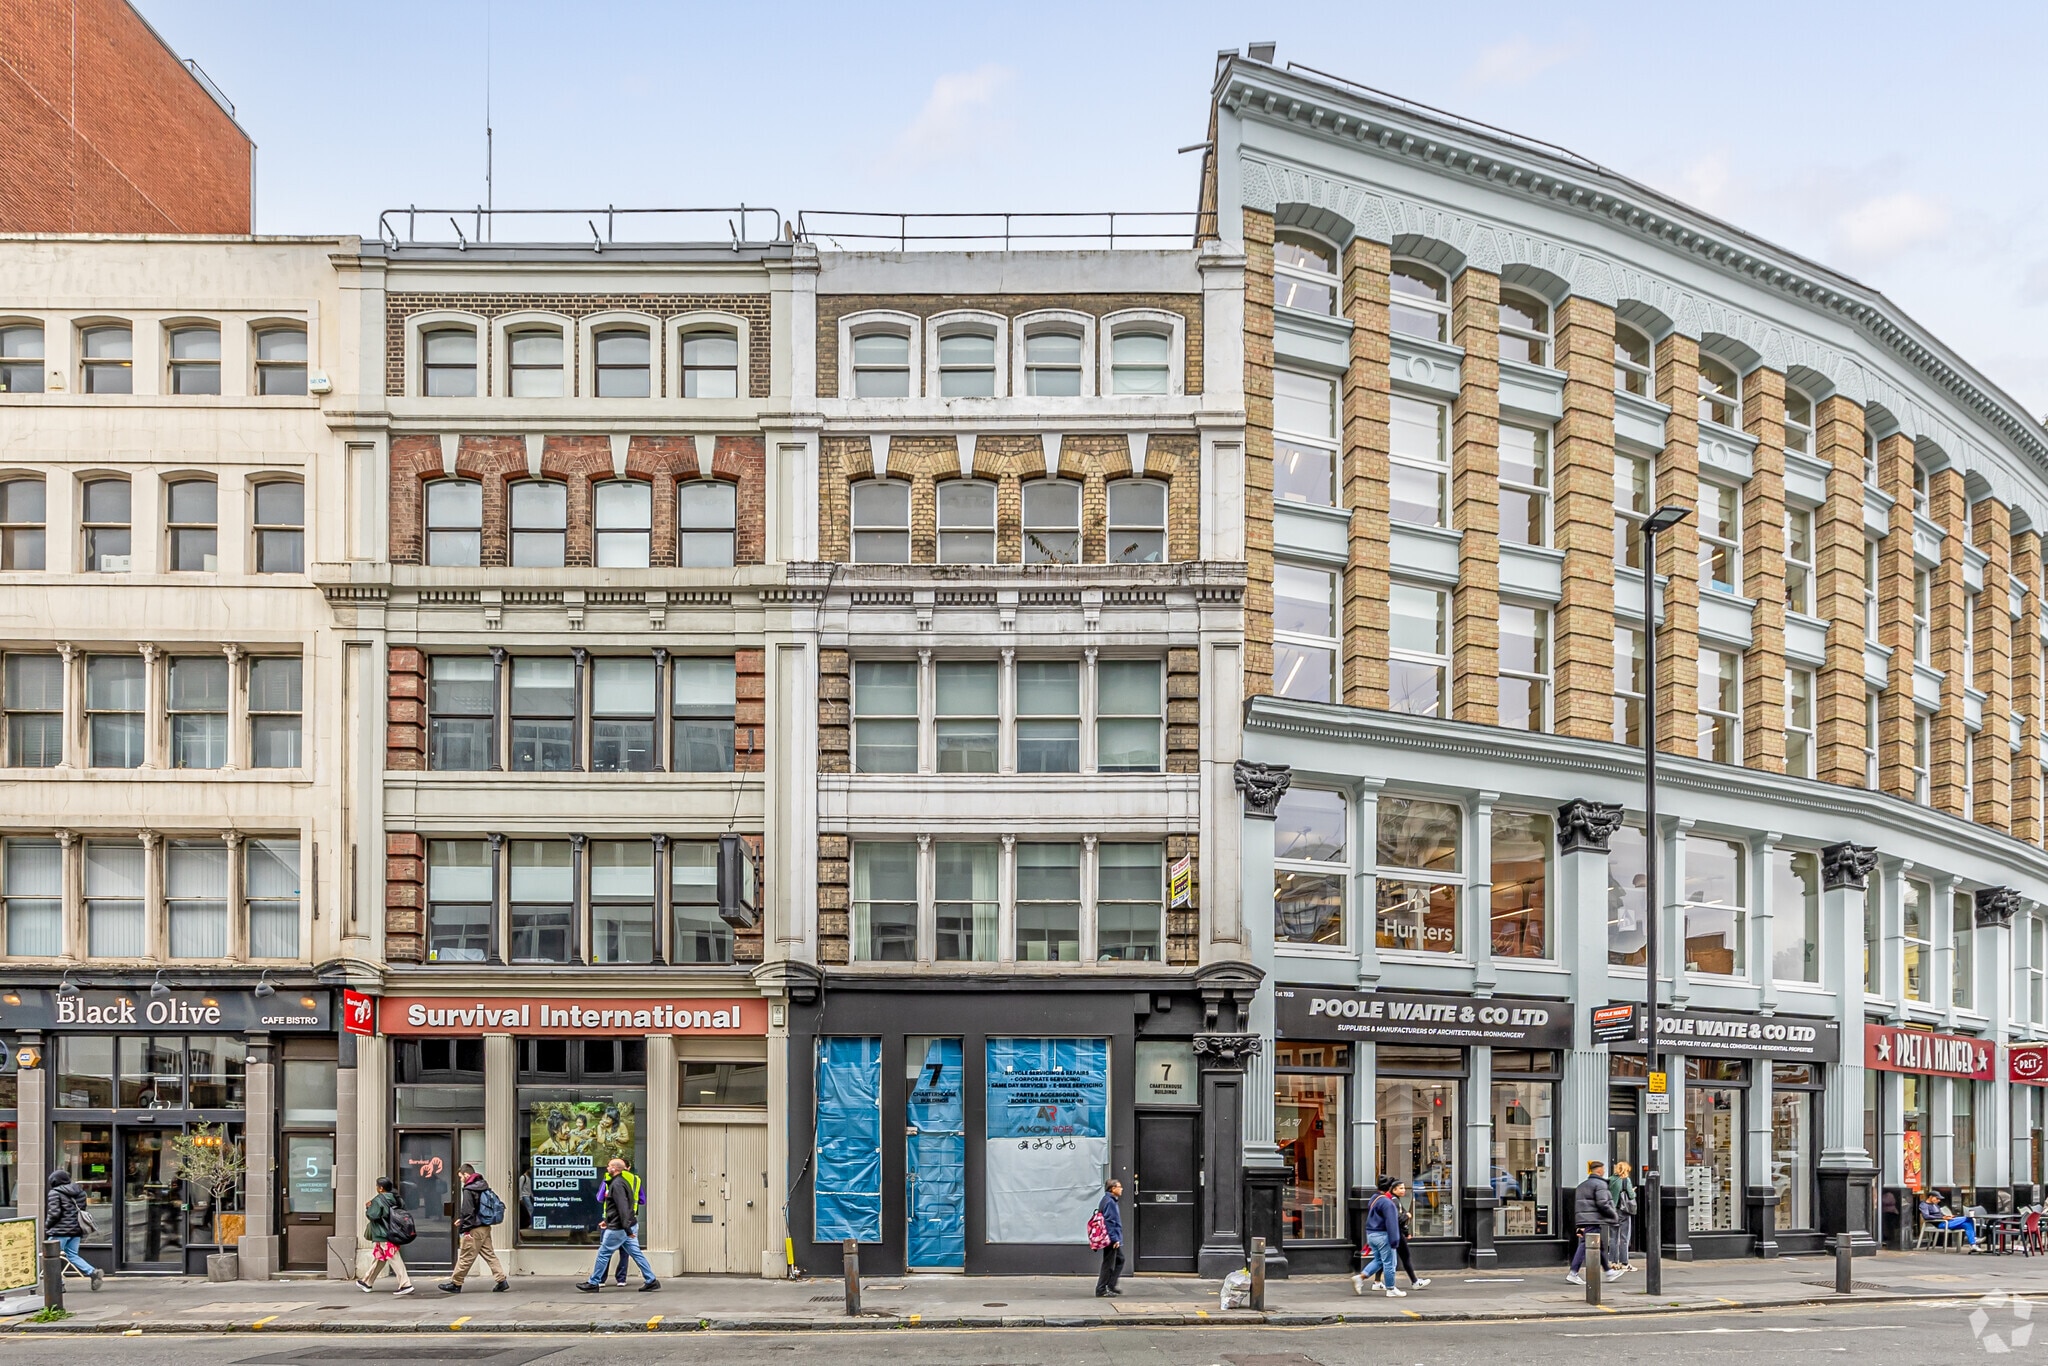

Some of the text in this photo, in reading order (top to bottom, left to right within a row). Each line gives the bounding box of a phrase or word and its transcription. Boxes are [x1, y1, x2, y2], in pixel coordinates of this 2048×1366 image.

[1384, 919, 1453, 941] Hunters
[56, 998, 221, 1024] Black Olive
[408, 1004, 740, 1028] Survival International
[1308, 998, 1549, 1026] POOLE WAITE & CO LTD
[262, 1016, 318, 1024] CAFE BISTRO
[1376, 1026, 1427, 1034] MANUFACTURERS
[1436, 1028, 1482, 1037] ARCHITECTURAL
[1696, 1020, 1748, 1038] WAITE
[1748, 1024, 1762, 1038] &
[1762, 1024, 1786, 1040] CO
[1786, 1026, 1816, 1042] LTD
[1894, 1033, 1974, 1073] PRET A MANGER
[1161, 1064, 1172, 1081] 7
[2020, 1059, 2037, 1069] PRET
[926, 1064, 944, 1086] 7
[737, 1112, 768, 1121] Building
[1037, 1105, 1057, 1122] AR
[306, 1157, 318, 1177] 5
[536, 1156, 590, 1165] Stand with
[536, 1168, 594, 1178] Indigenous
[536, 1180, 577, 1189] peoples
